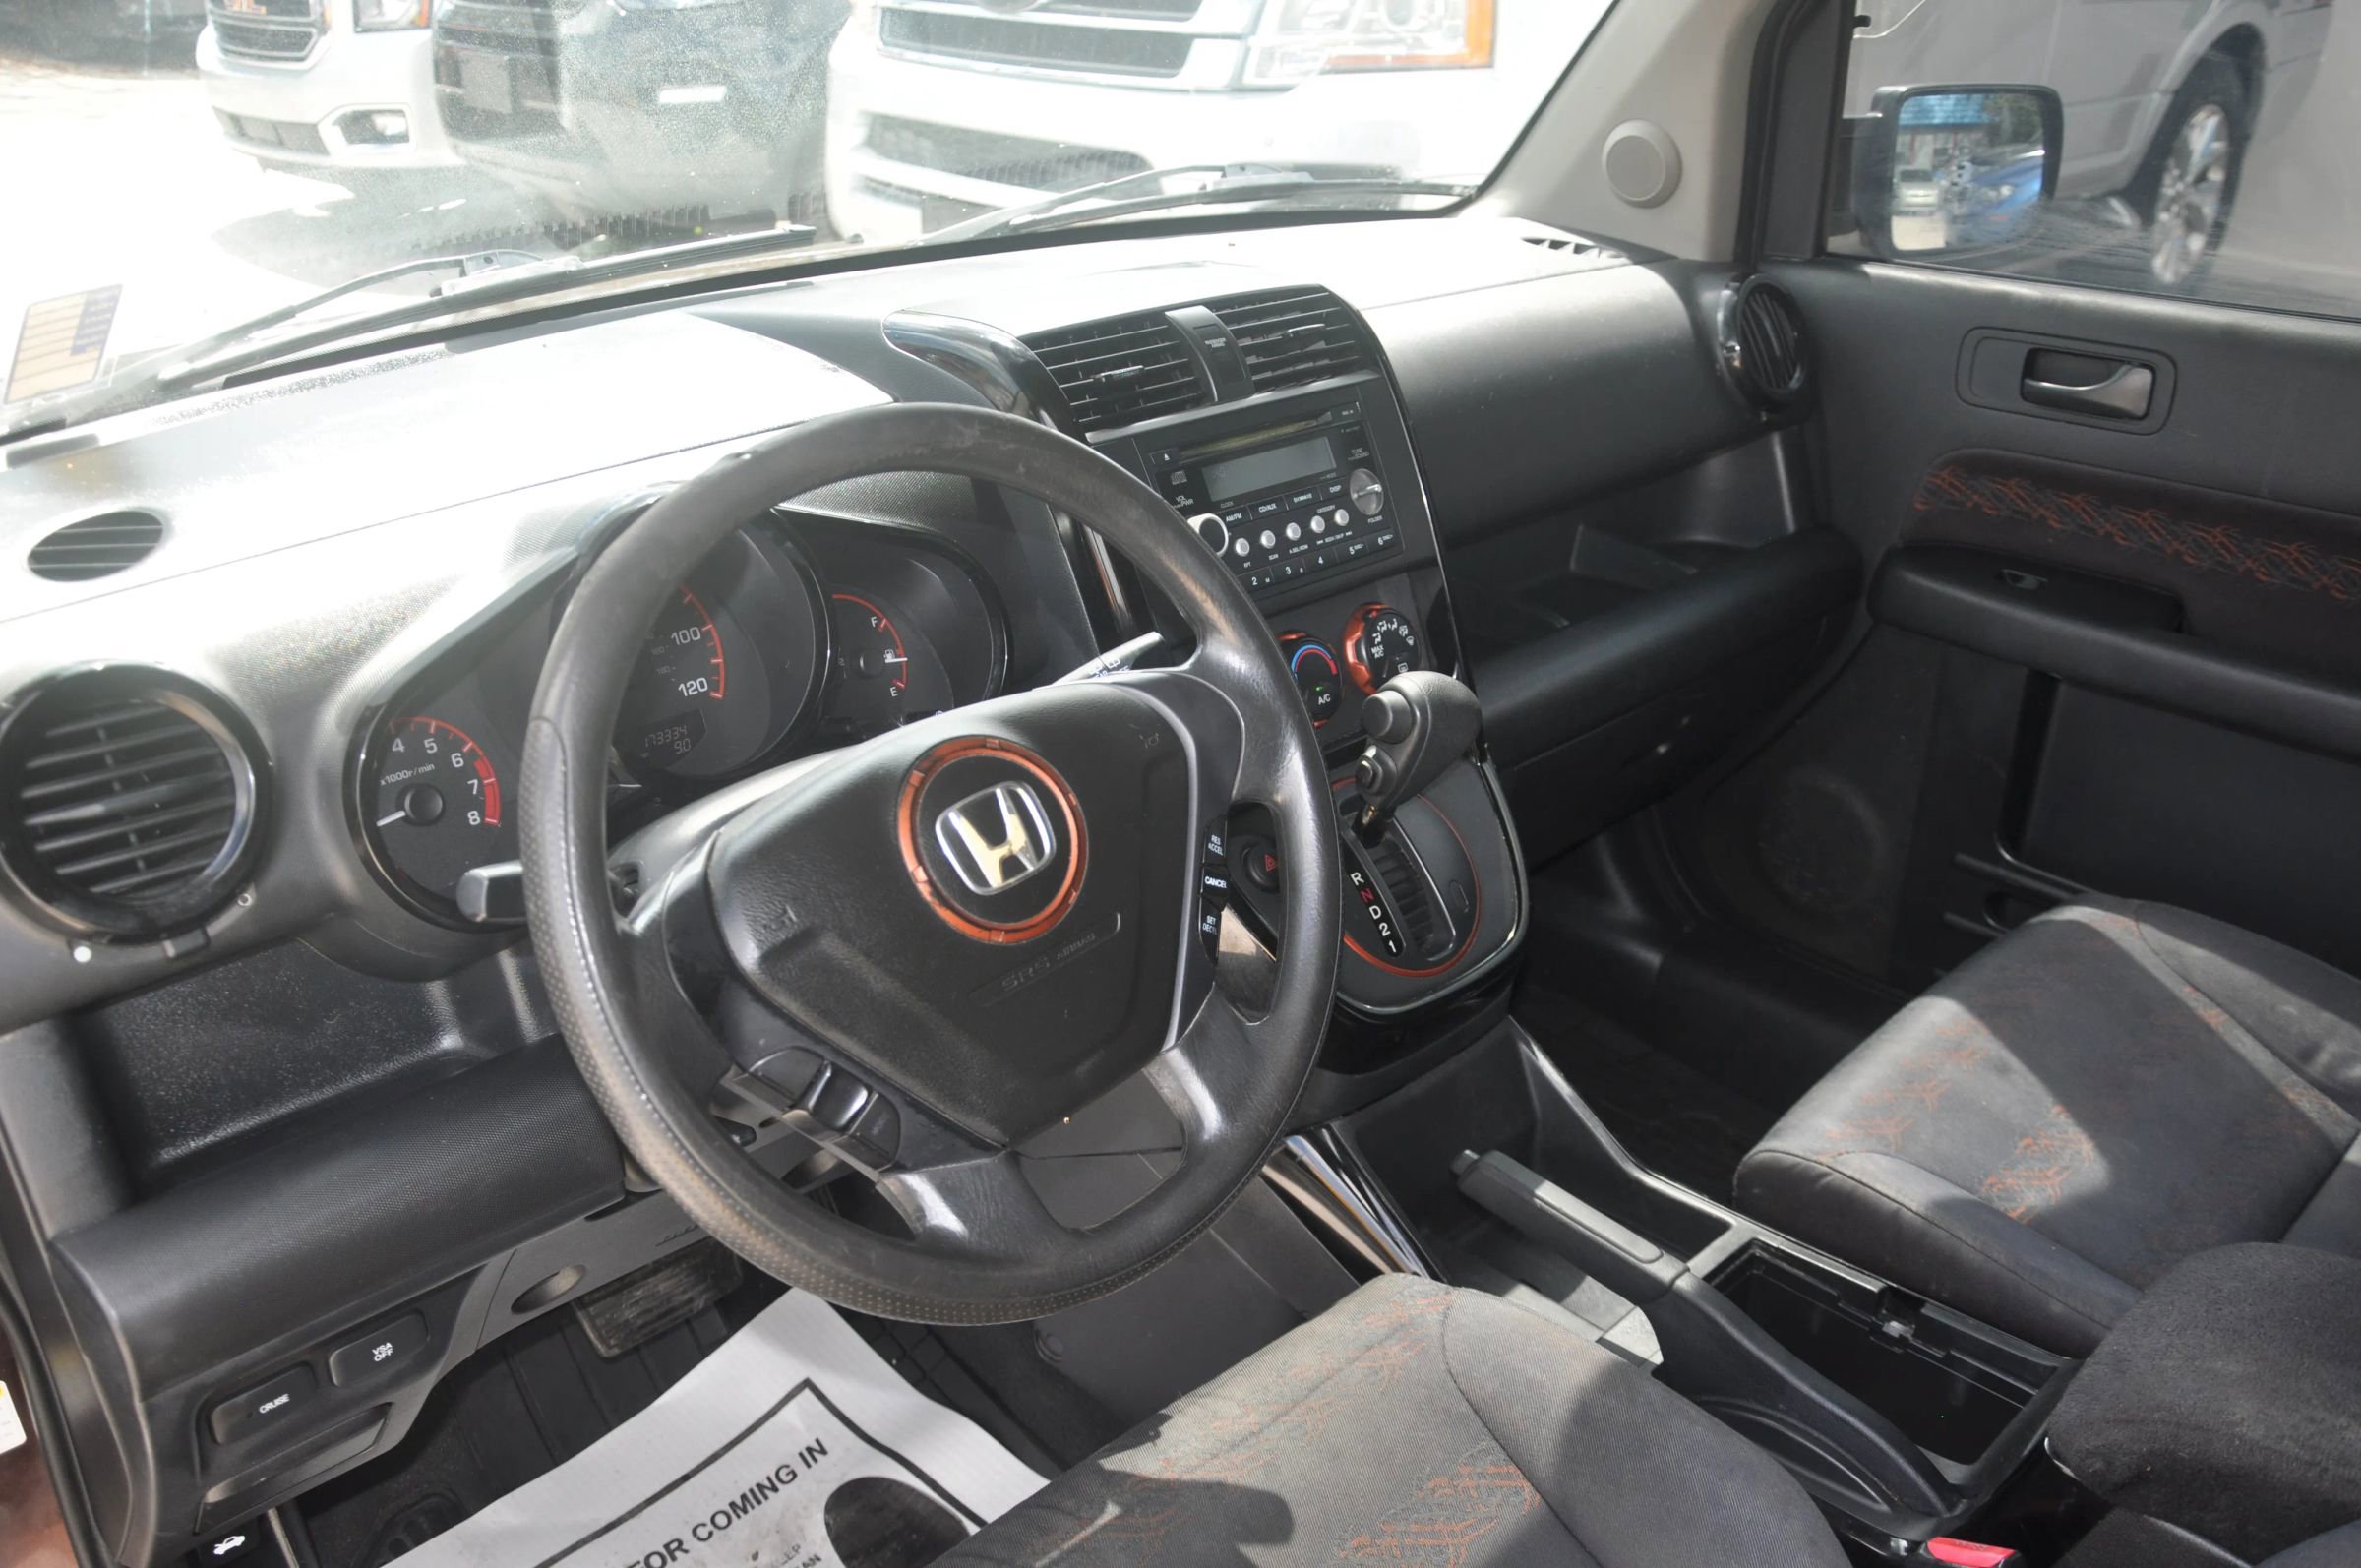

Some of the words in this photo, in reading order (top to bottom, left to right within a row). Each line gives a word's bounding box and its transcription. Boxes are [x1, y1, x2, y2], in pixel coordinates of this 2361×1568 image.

[1226, 513, 1242, 522] AM/FM
[1377, 536, 1384, 546] 6
[1349, 546, 1355, 555] 5
[1318, 556, 1324, 565] 4
[1285, 566, 1292, 575] 3
[1251, 576, 1258, 586] 2
[871, 616, 878, 628] F
[670, 626, 701, 646] 100
[1371, 644, 1384, 653] MAX
[1374, 650, 1385, 659] A/C
[678, 677, 708, 697] 120
[889, 686, 898, 697] E
[1318, 693, 1331, 706] A/C
[392, 738, 405, 753] 4
[423, 738, 439, 754] 5
[451, 753, 464, 768] 6
[466, 778, 480, 795] 7
[467, 811, 481, 825] 8
[1211, 834, 1221, 845] RES
[1208, 842, 1224, 856] ACCEL
[1204, 875, 1228, 888] CANCEL
[1350, 872, 1365, 886] R
[1360, 887, 1375, 903] N
[1368, 905, 1382, 920] D
[1378, 922, 1391, 936] 2
[1388, 939, 1397, 953] 1
[1206, 915, 1217, 926] SET
[372, 1342, 394, 1356] VSA
[374, 1348, 394, 1362] OFF
[259, 1393, 290, 1414] CRUISE
[691, 1464, 799, 1543] COMING
[798, 1437, 829, 1470] IN
